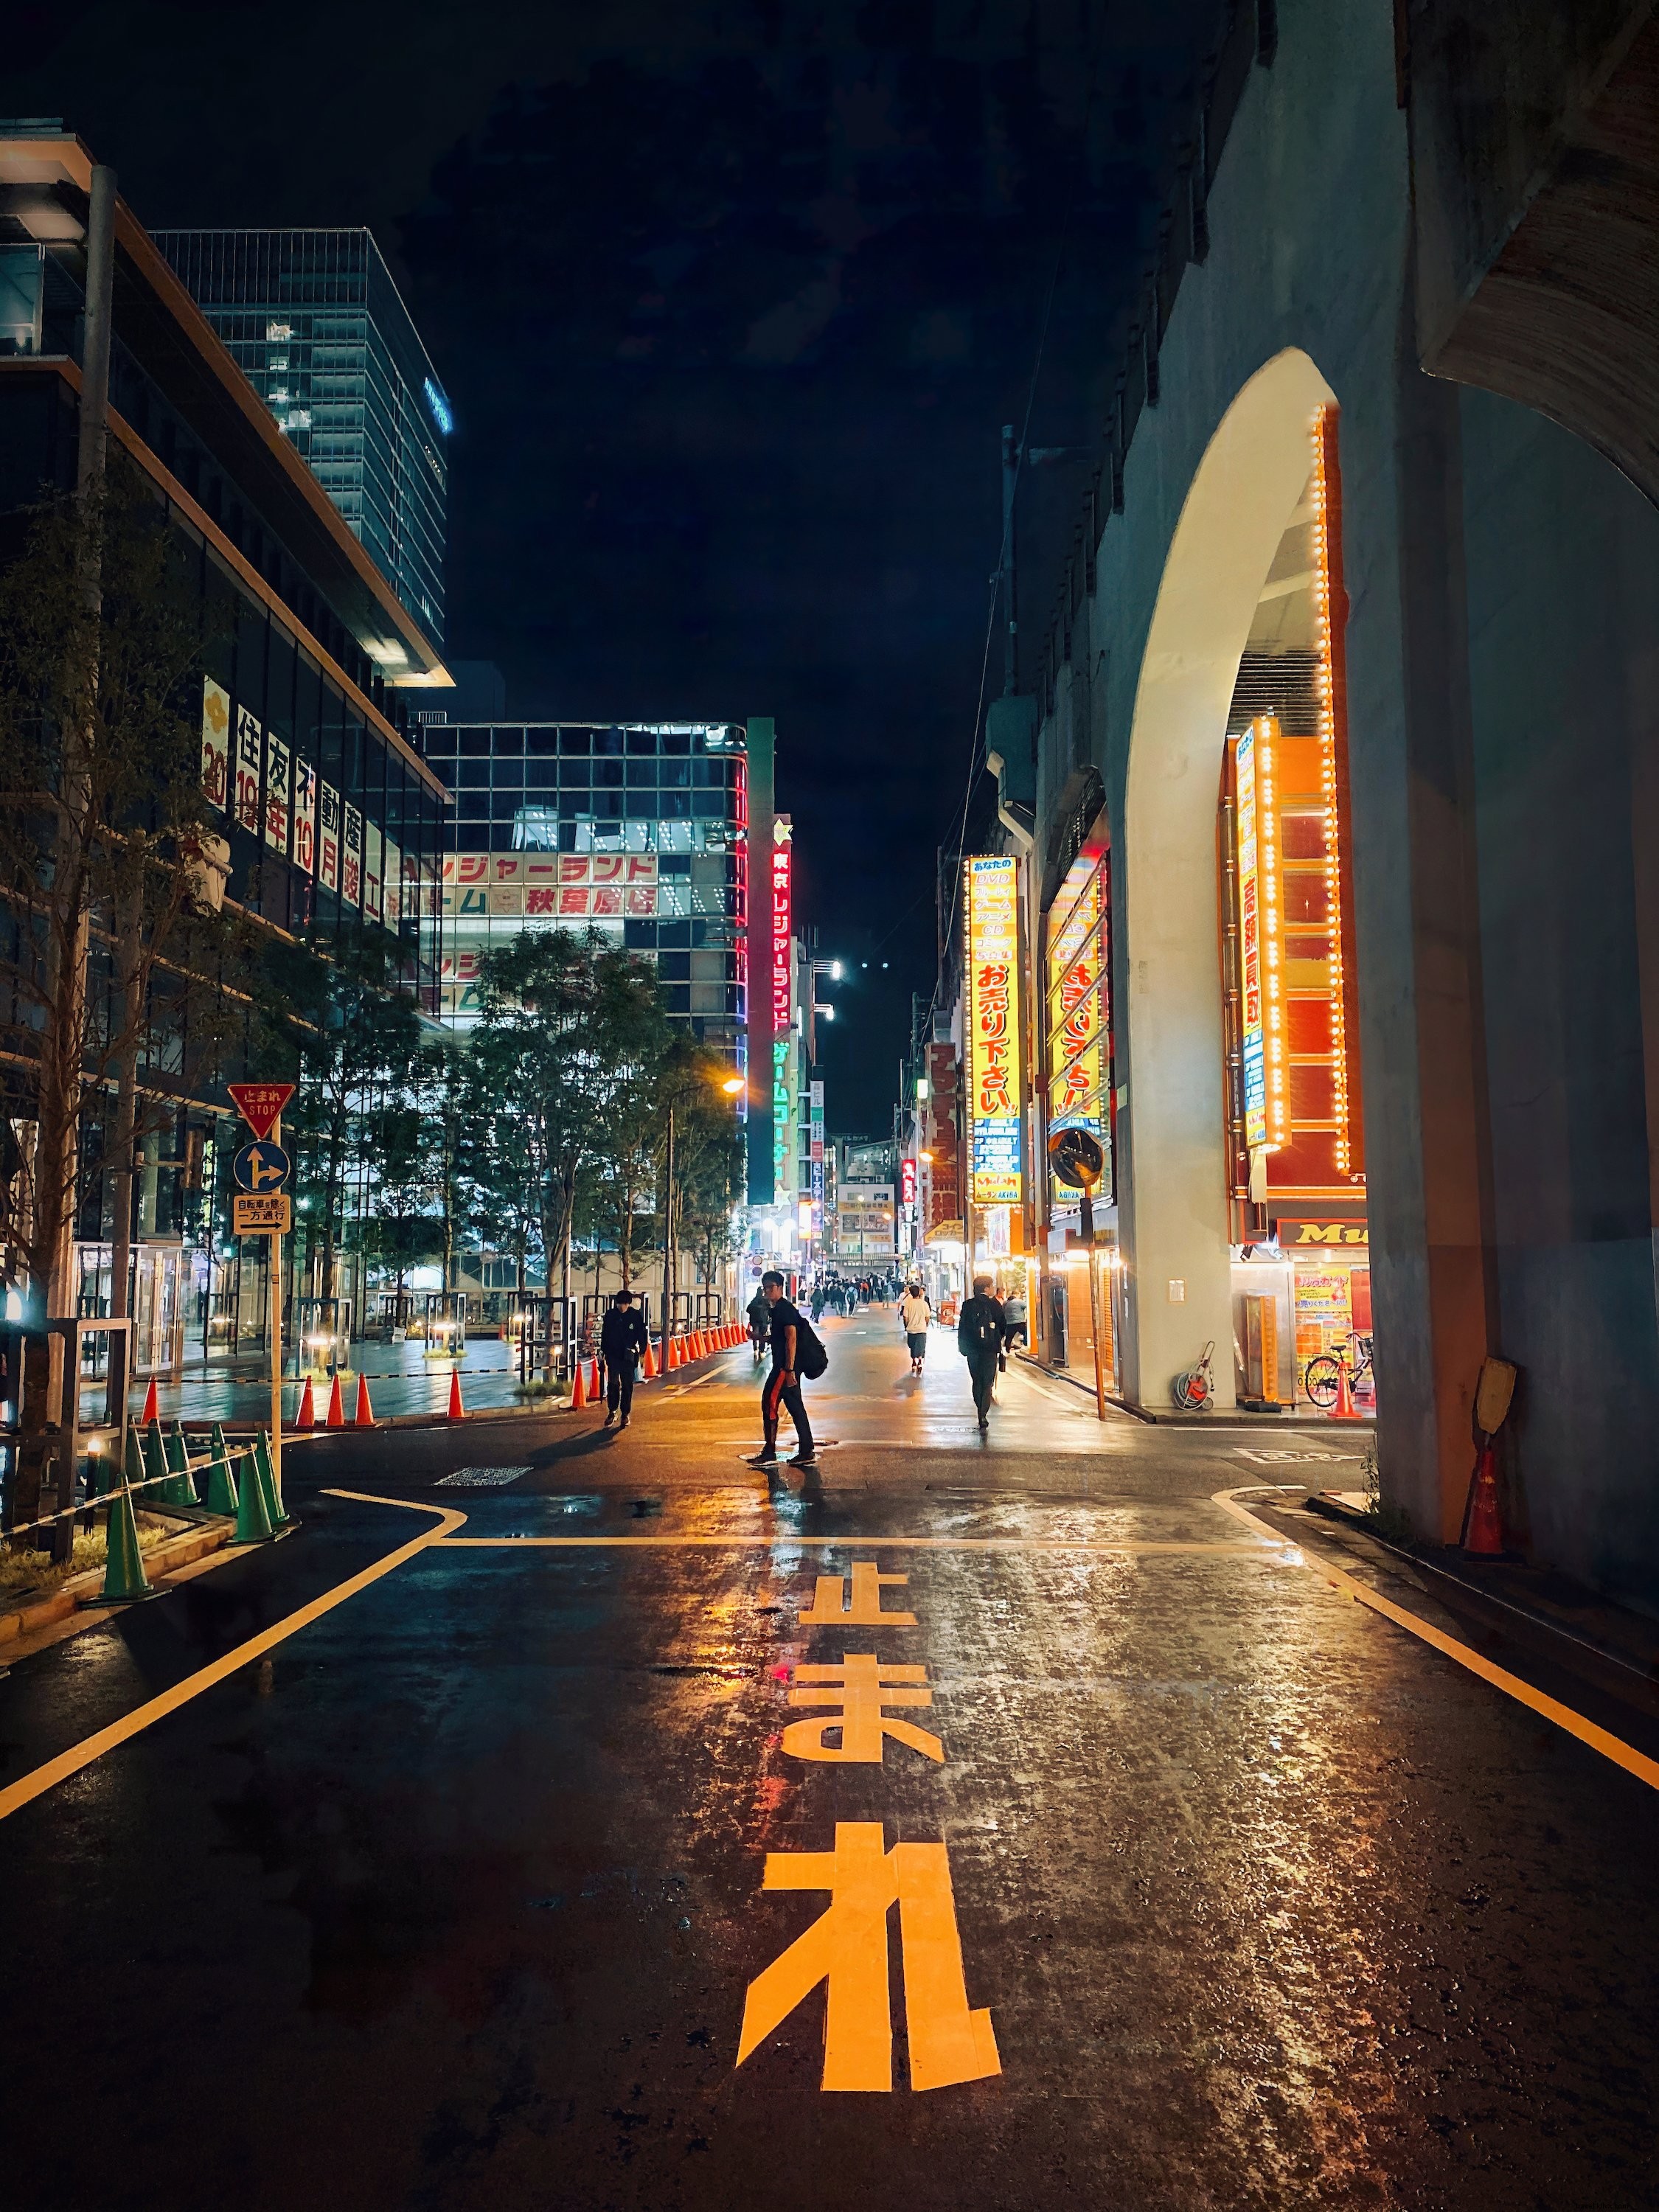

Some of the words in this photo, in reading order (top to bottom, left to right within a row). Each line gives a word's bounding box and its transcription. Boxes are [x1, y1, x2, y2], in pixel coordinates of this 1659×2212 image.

[237, 713, 361, 855] 住友不動産
[974, 859, 1011, 871] あなたの
[976, 873, 1009, 885] DVD
[526, 888, 657, 914] 秋葉原店
[976, 913, 1010, 922] アニメ
[982, 925, 1004, 935] CD
[773, 852, 789, 1031] 東京レジャーランド
[244, 1090, 281, 1102] 止まれ
[249, 1105, 276, 1116] STOP
[998, 1191, 1018, 1199] AKIBA
[238, 1199, 285, 1209] 自転車を除く
[238, 1210, 285, 1220] 一方通行
[737, 1561, 1001, 2093] 止まれ
